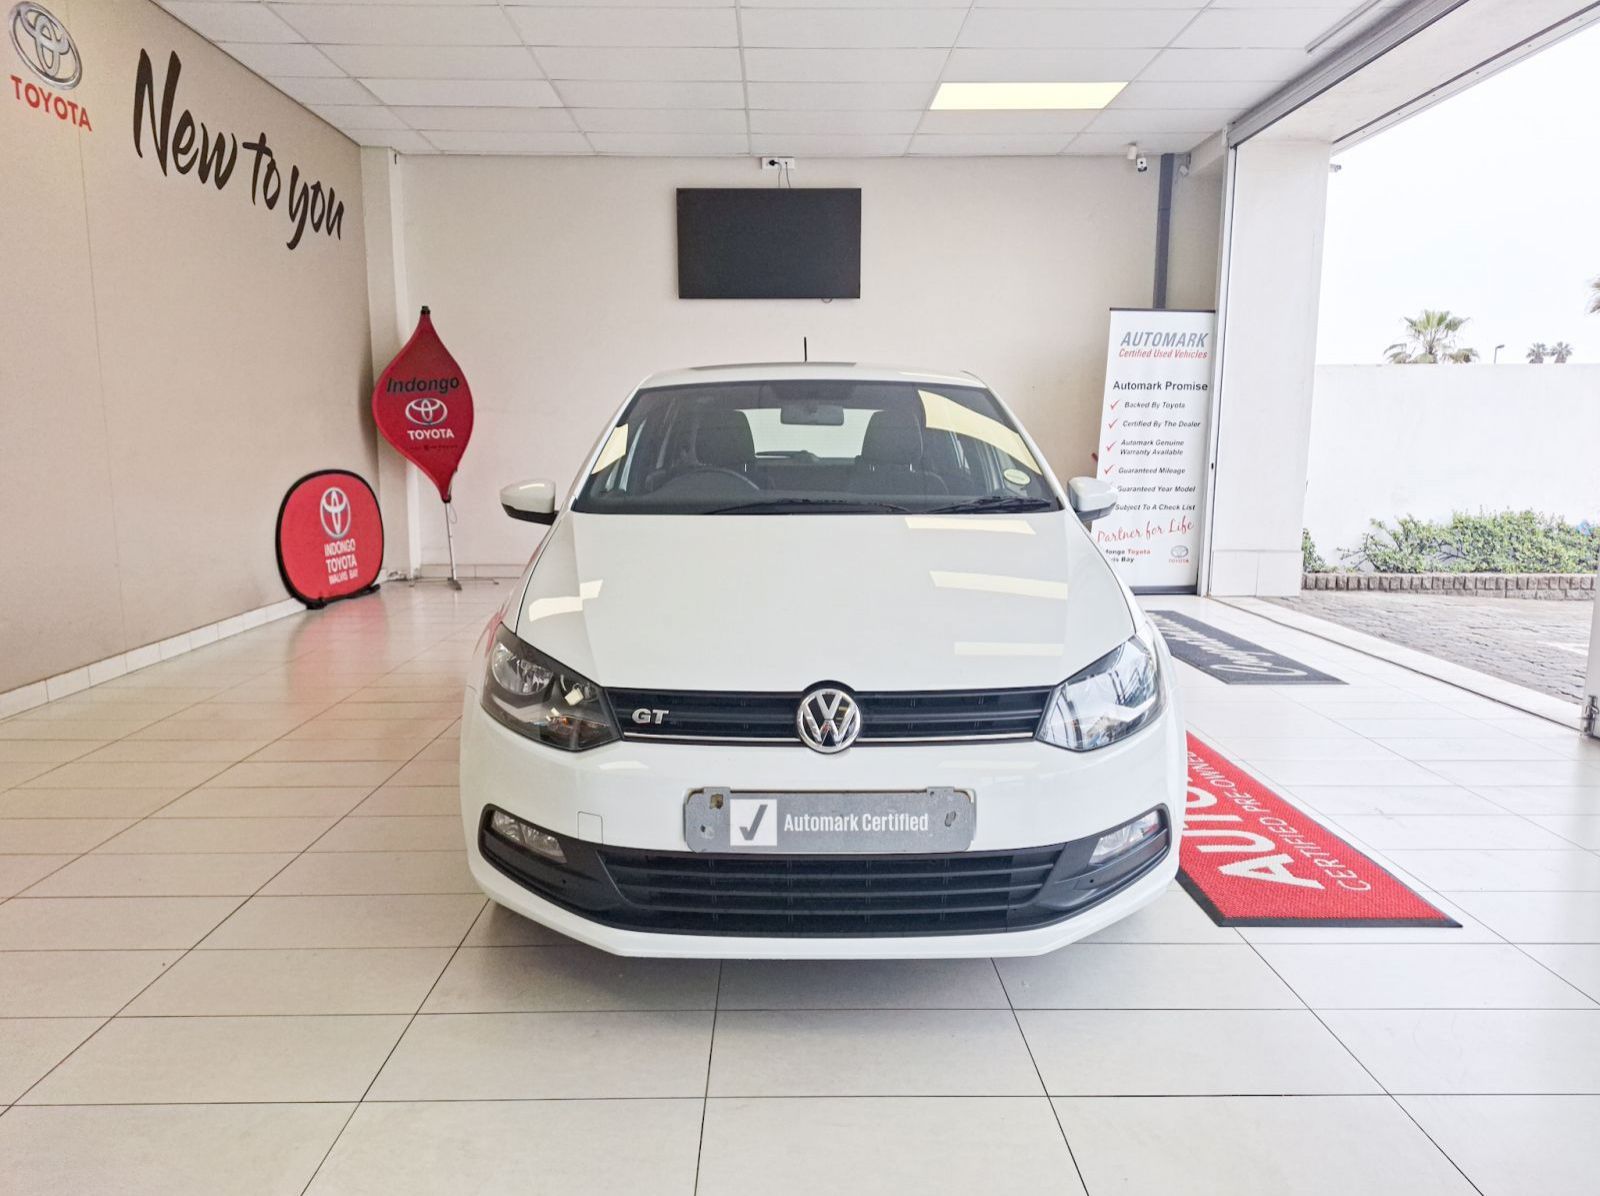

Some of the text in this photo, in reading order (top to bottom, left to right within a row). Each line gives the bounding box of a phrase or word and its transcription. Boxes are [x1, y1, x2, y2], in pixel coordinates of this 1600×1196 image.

[10, 74, 92, 132] TOYOTA
[133, 48, 345, 250] New to you
[1120, 331, 1208, 348] AUTOMARK
[1119, 348, 1208, 359] Certified Used Vehicles
[386, 377, 460, 393] Indongo
[1113, 381, 1208, 391] Automark Promise
[1124, 401, 1150, 409] Backed
[1162, 402, 1185, 410] Toyota
[1122, 420, 1152, 428] Certified
[1164, 420, 1177, 428] The
[1178, 420, 1201, 428] Dealer
[407, 428, 455, 440] TOYOTA
[1120, 448, 1183, 456] Warranty Available
[1159, 467, 1185, 475] Mileage
[1097, 515, 1195, 543] Partner for Life
[324, 538, 356, 557] INDONGO
[325, 553, 358, 574] TOYOTA
[631, 708, 669, 724] GT
[784, 813, 930, 832] Automark Certified
[1259, 816, 1373, 892] CERTIFIED
